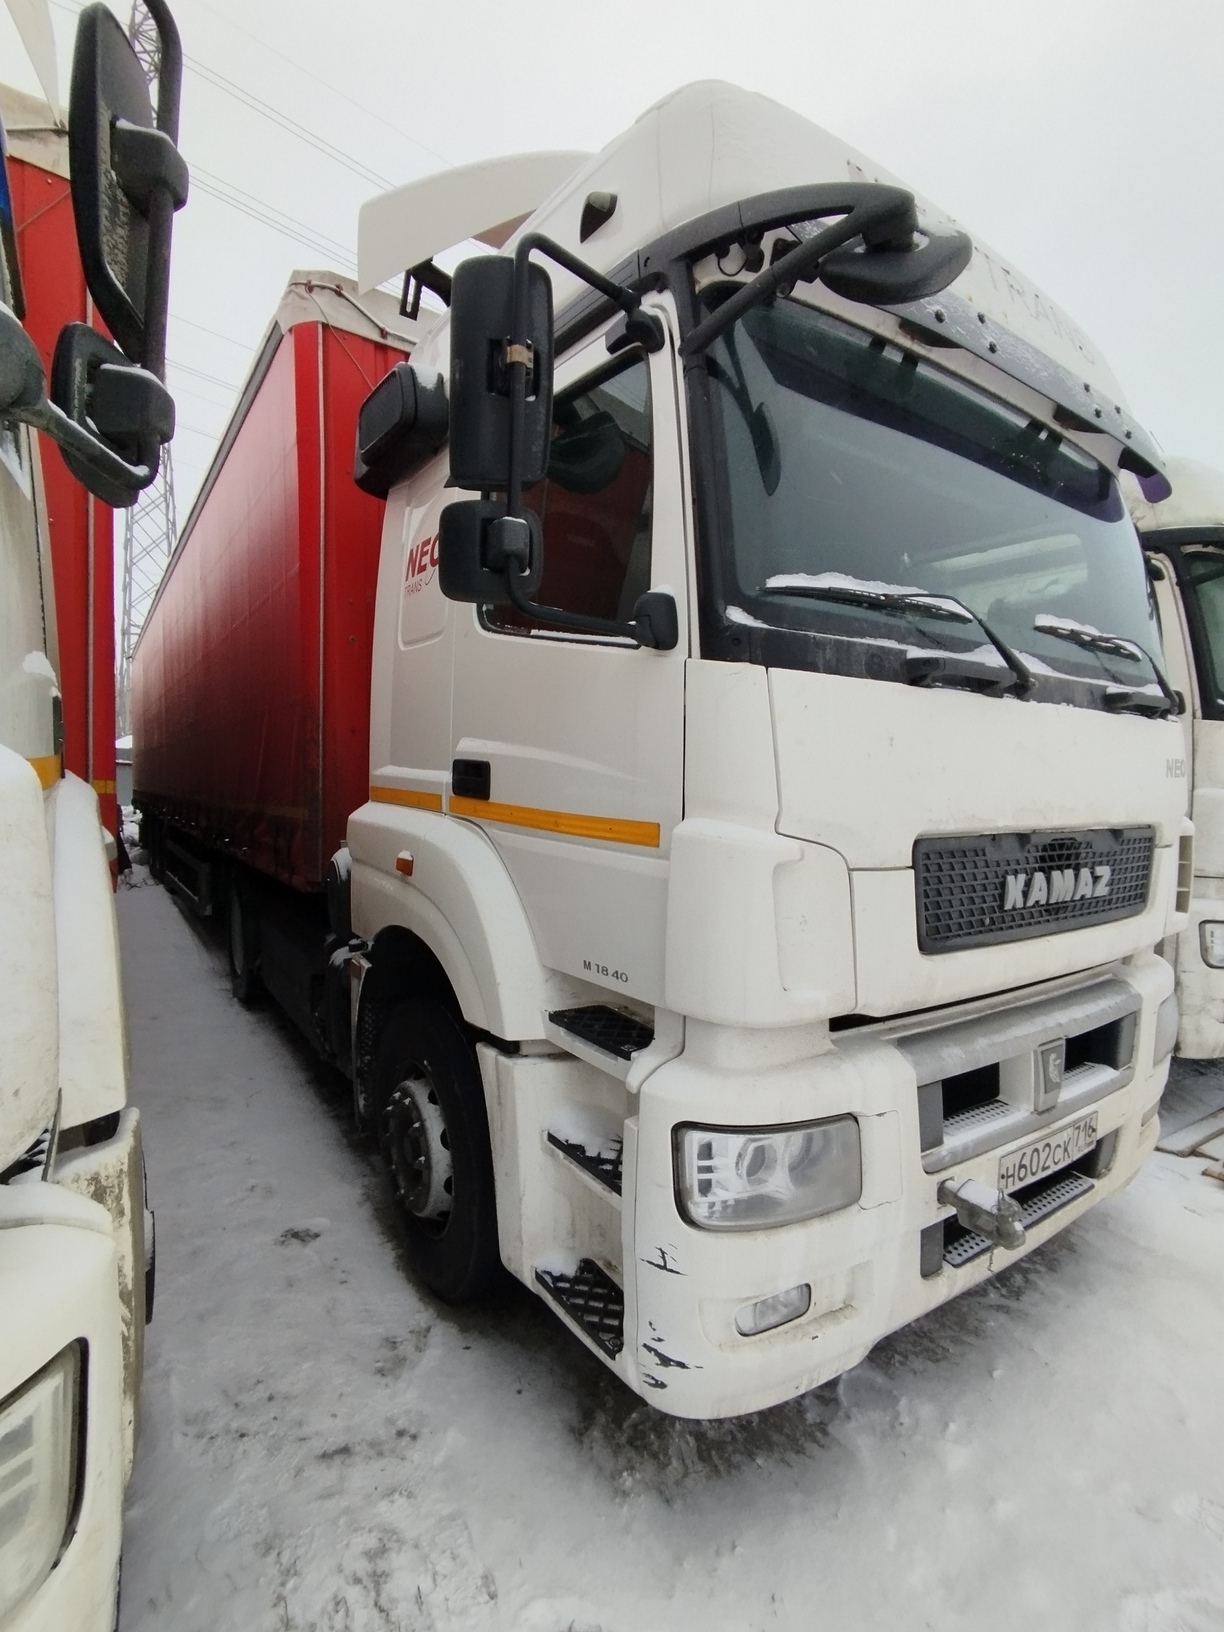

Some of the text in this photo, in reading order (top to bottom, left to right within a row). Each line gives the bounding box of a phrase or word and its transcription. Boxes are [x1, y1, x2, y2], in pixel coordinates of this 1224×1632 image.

[404, 578, 423, 598] TRANS
[1166, 758, 1186, 778] NEO
[1003, 865, 1112, 911] KAMAZ
[583, 959, 592, 971] M
